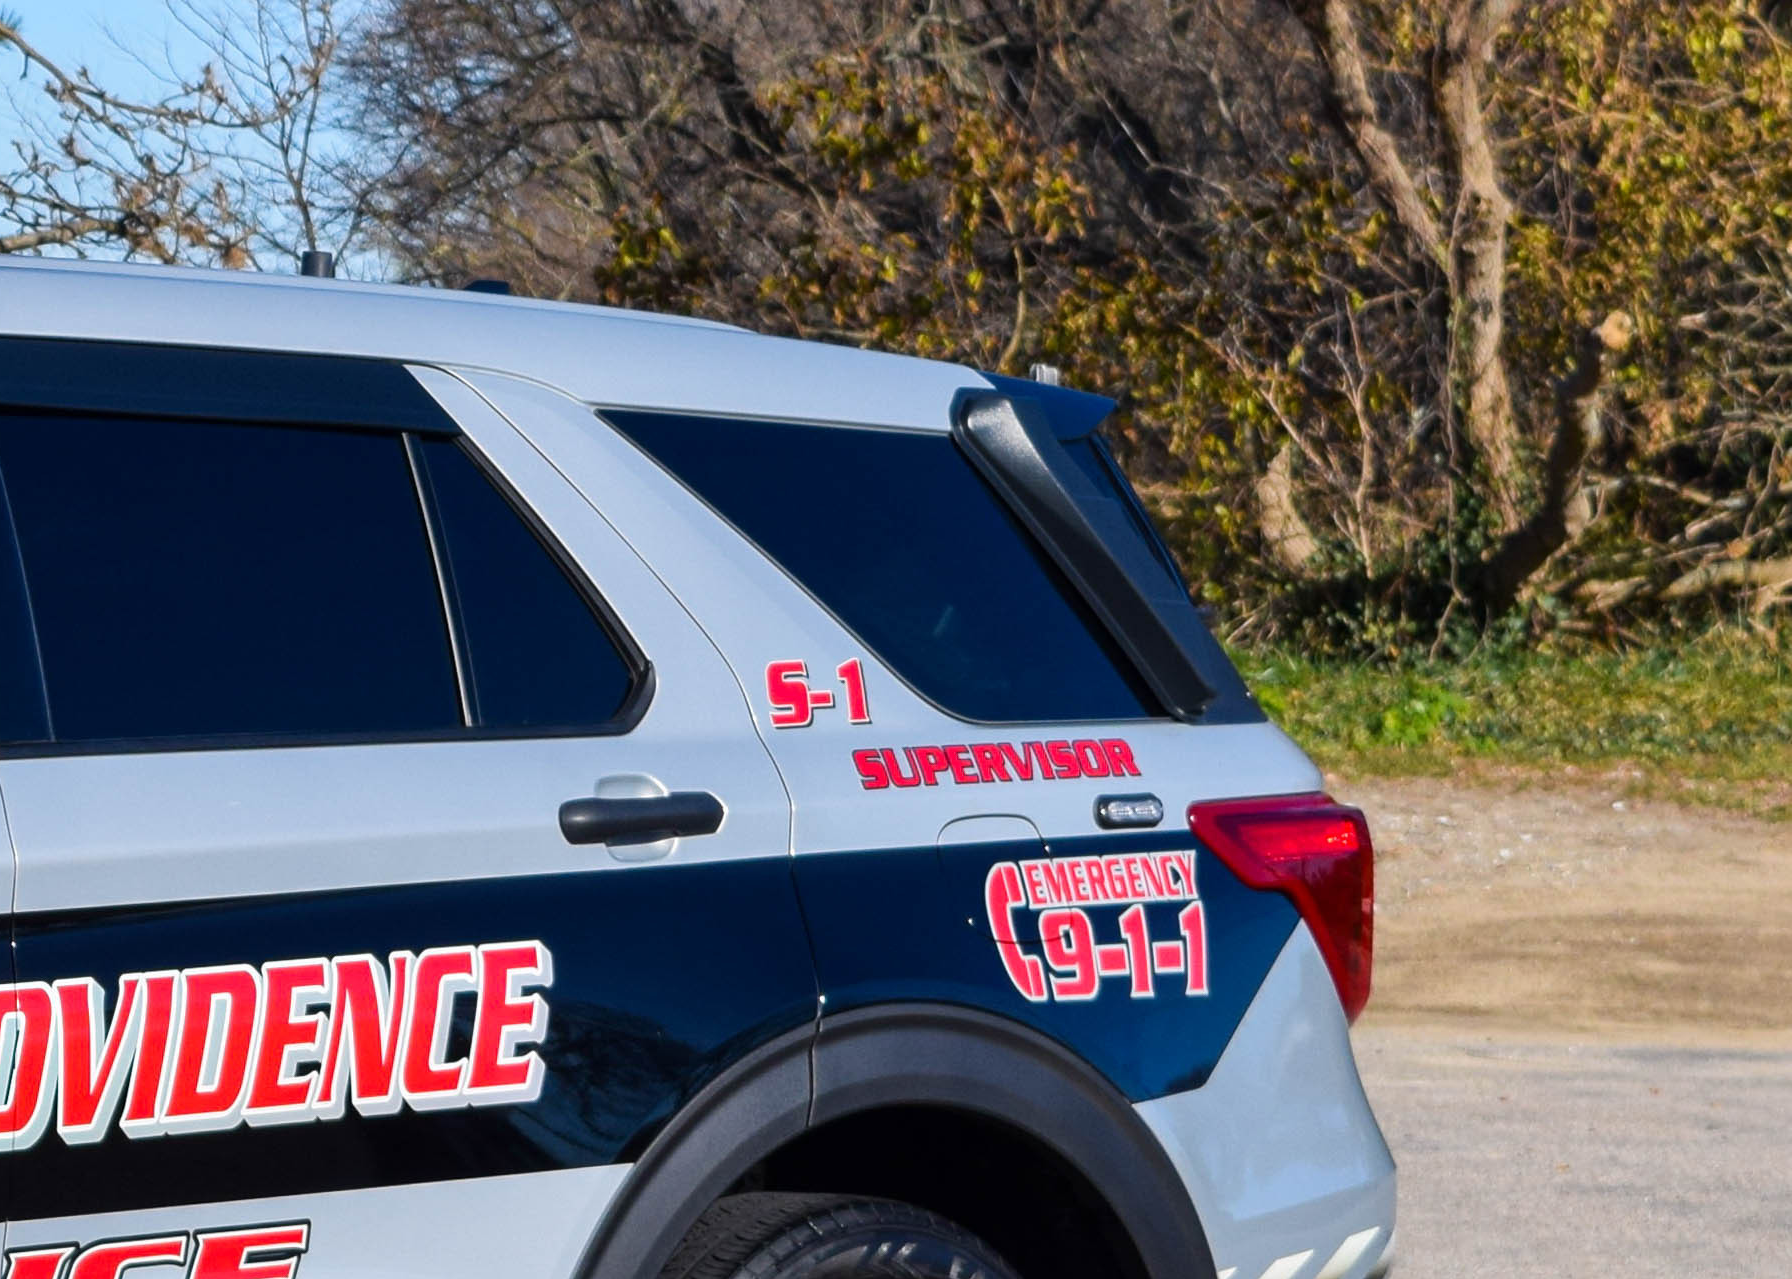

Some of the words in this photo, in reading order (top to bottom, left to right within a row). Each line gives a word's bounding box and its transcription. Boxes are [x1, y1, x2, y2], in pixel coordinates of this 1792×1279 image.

[765, 657, 871, 729] S-1
[852, 737, 1142, 791] SUPERVISOR
[1018, 849, 1199, 910] EMERGENCY
[1038, 900, 1209, 1002] 9-1-1
